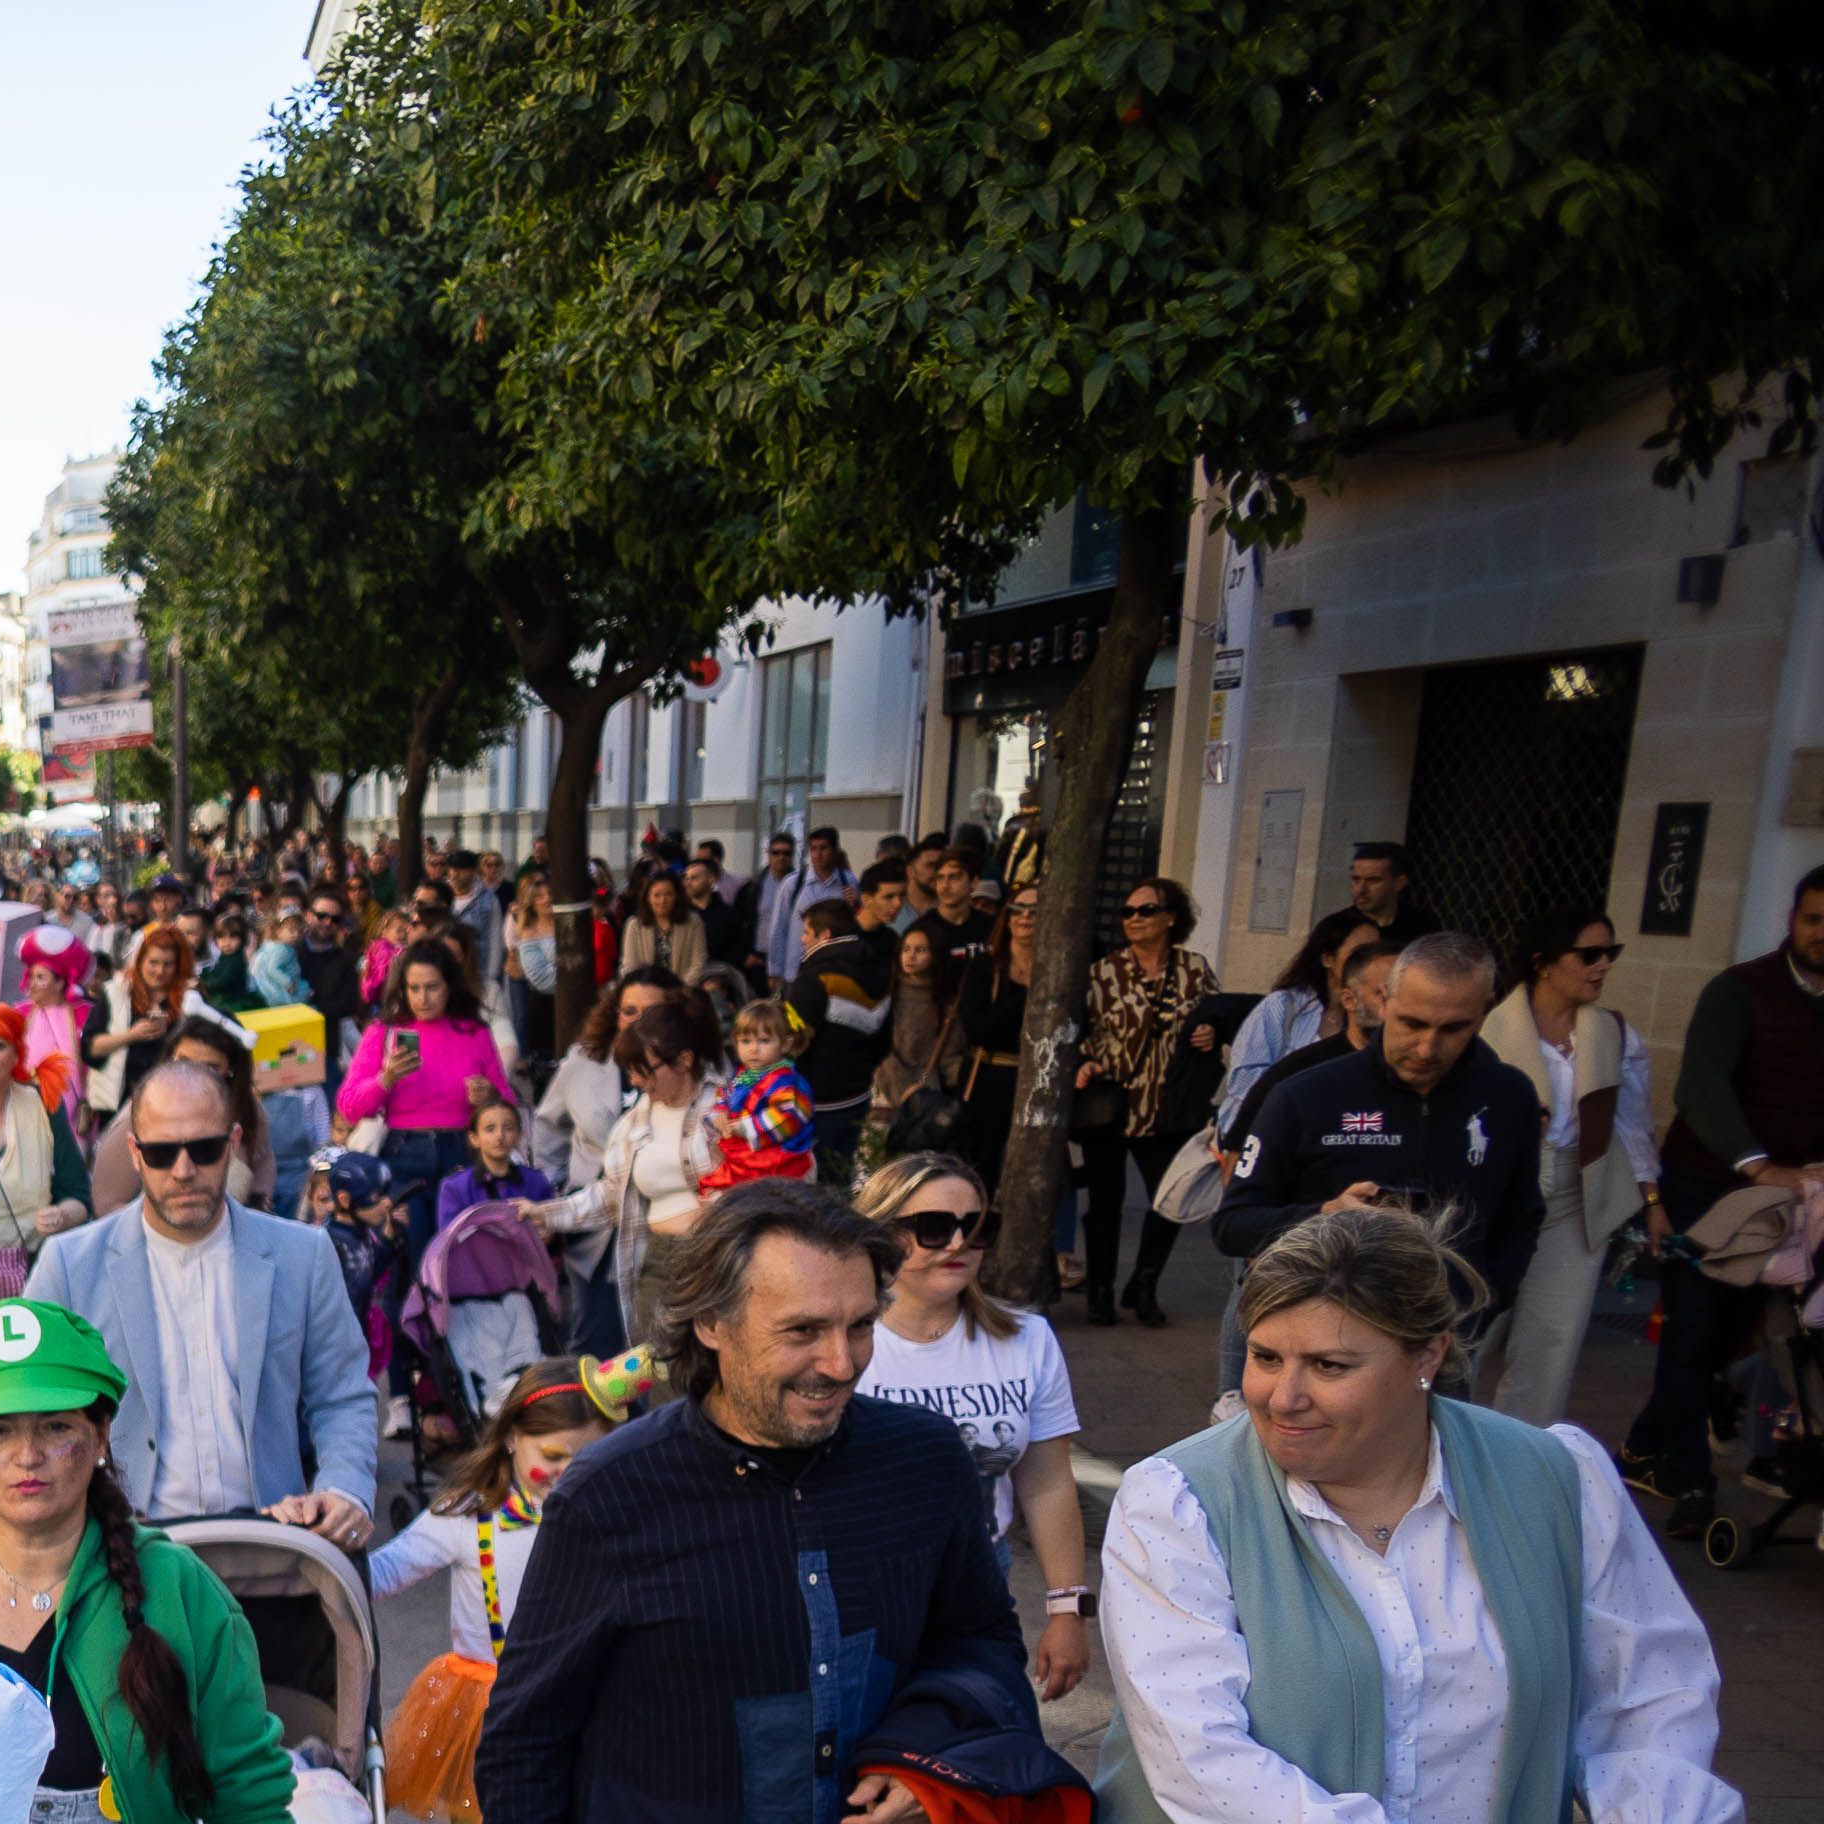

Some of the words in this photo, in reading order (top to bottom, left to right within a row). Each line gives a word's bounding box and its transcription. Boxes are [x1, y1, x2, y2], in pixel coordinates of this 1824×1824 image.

[1228, 566, 1246, 590] 27
[68, 711, 101, 726] TAKE
[102, 707, 137, 721] THAT
[1321, 1134, 1357, 1147] GREAT
[1358, 1134, 1403, 1146] BRITAIN
[1233, 1134, 1262, 1179] 3
[2, 1315, 26, 1342] L
